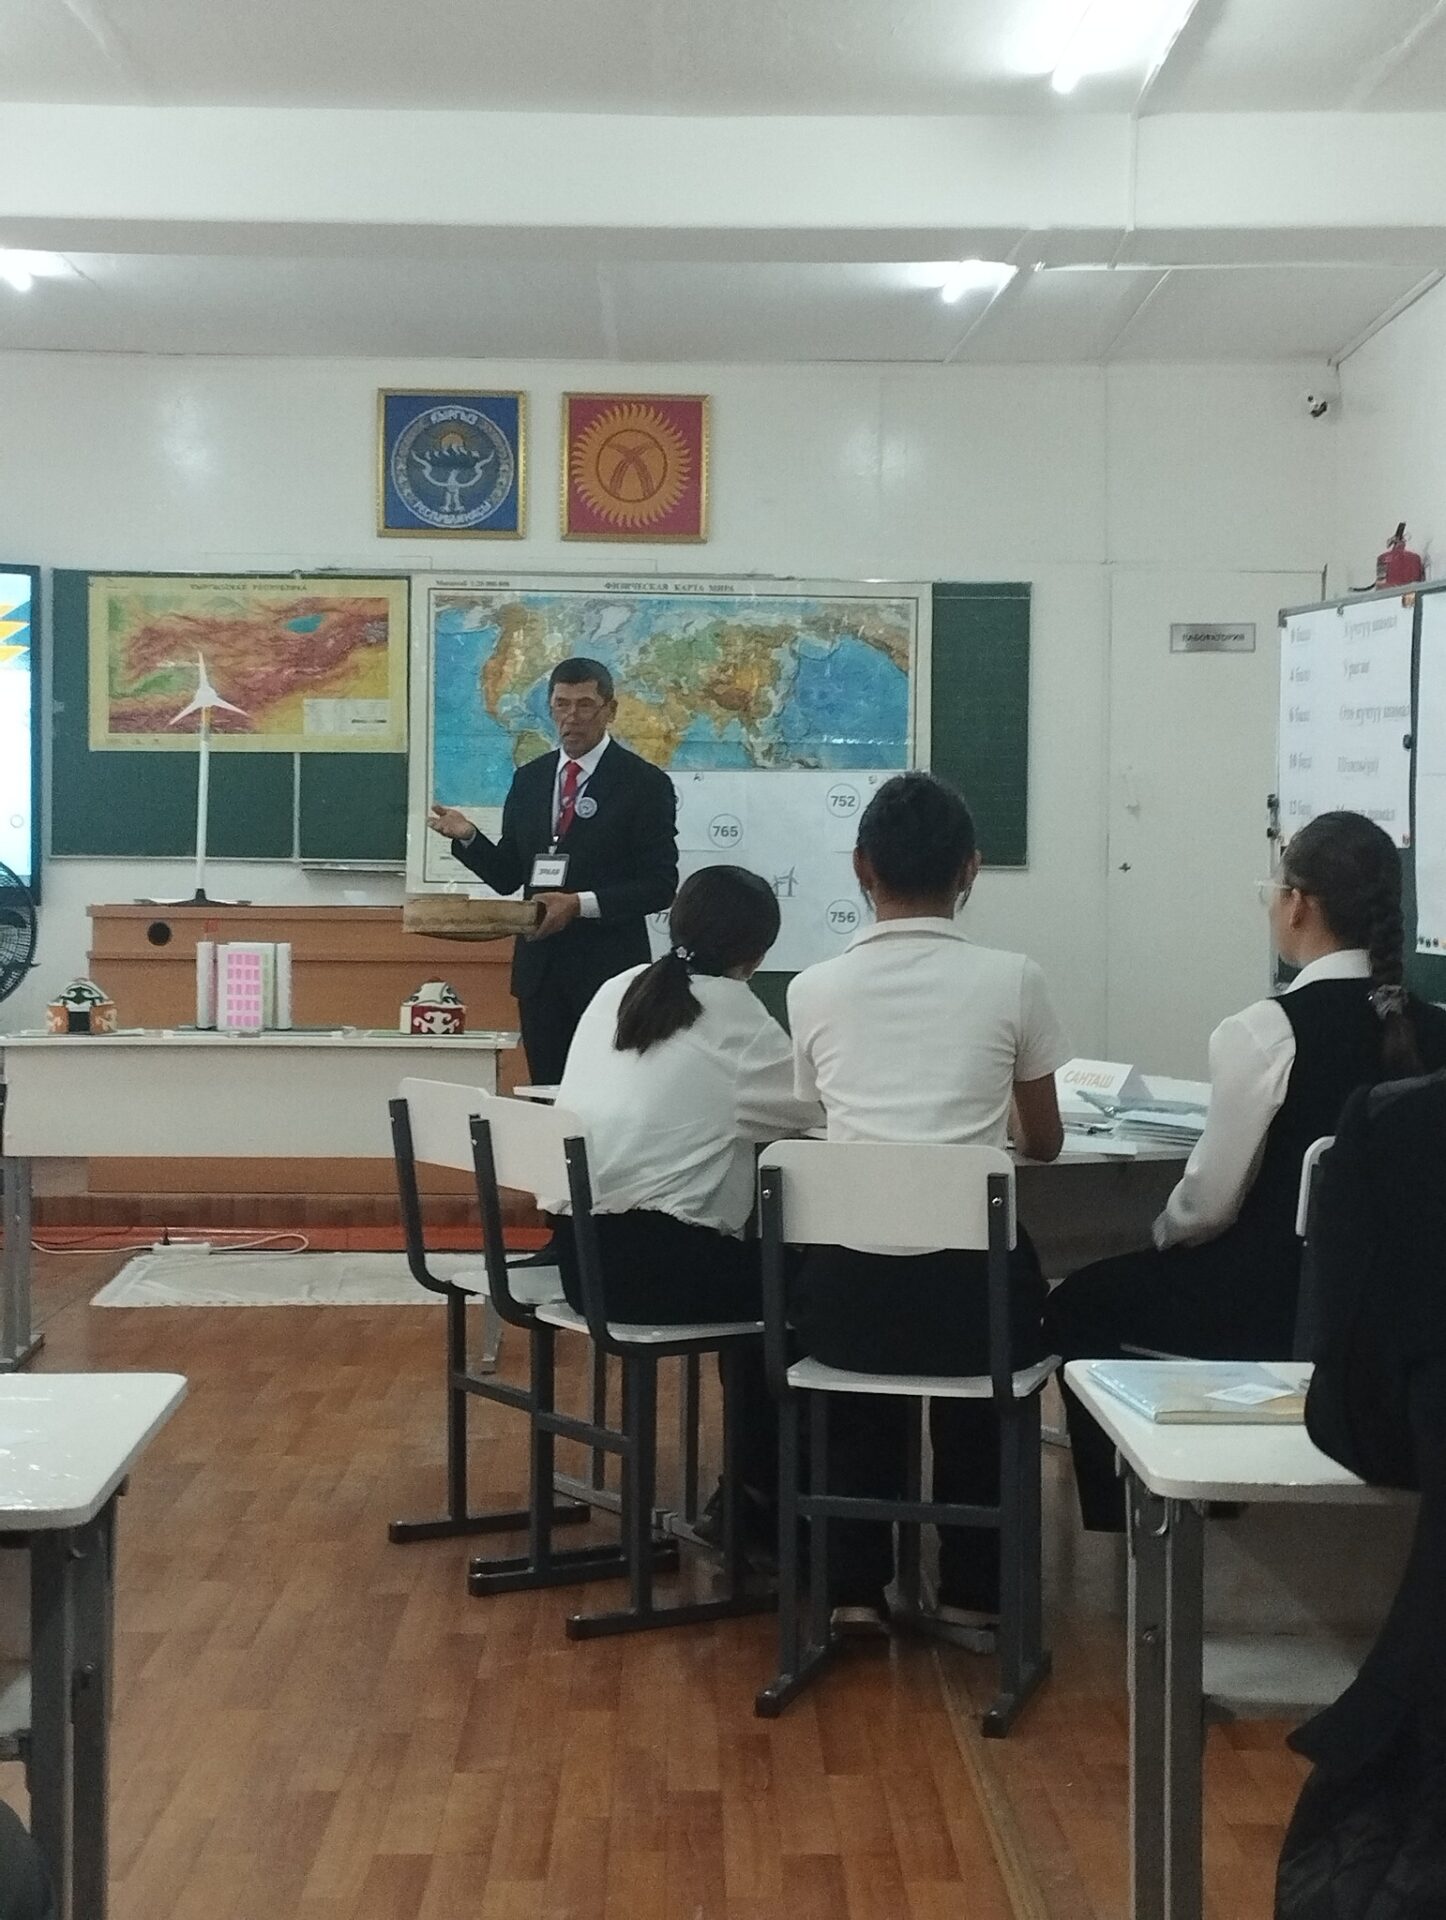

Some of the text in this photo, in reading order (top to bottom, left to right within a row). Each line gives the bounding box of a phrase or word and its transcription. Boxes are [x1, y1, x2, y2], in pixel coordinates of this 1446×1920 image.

[604, 582, 668, 591] ФИЗИЧЕСКАЯ
[674, 584, 704, 592] КАРТА
[830, 795, 856, 808] 752
[712, 825, 739, 838] 765
[830, 911, 856, 924] 756
[1063, 1070, 1114, 1089] САНТАШ
